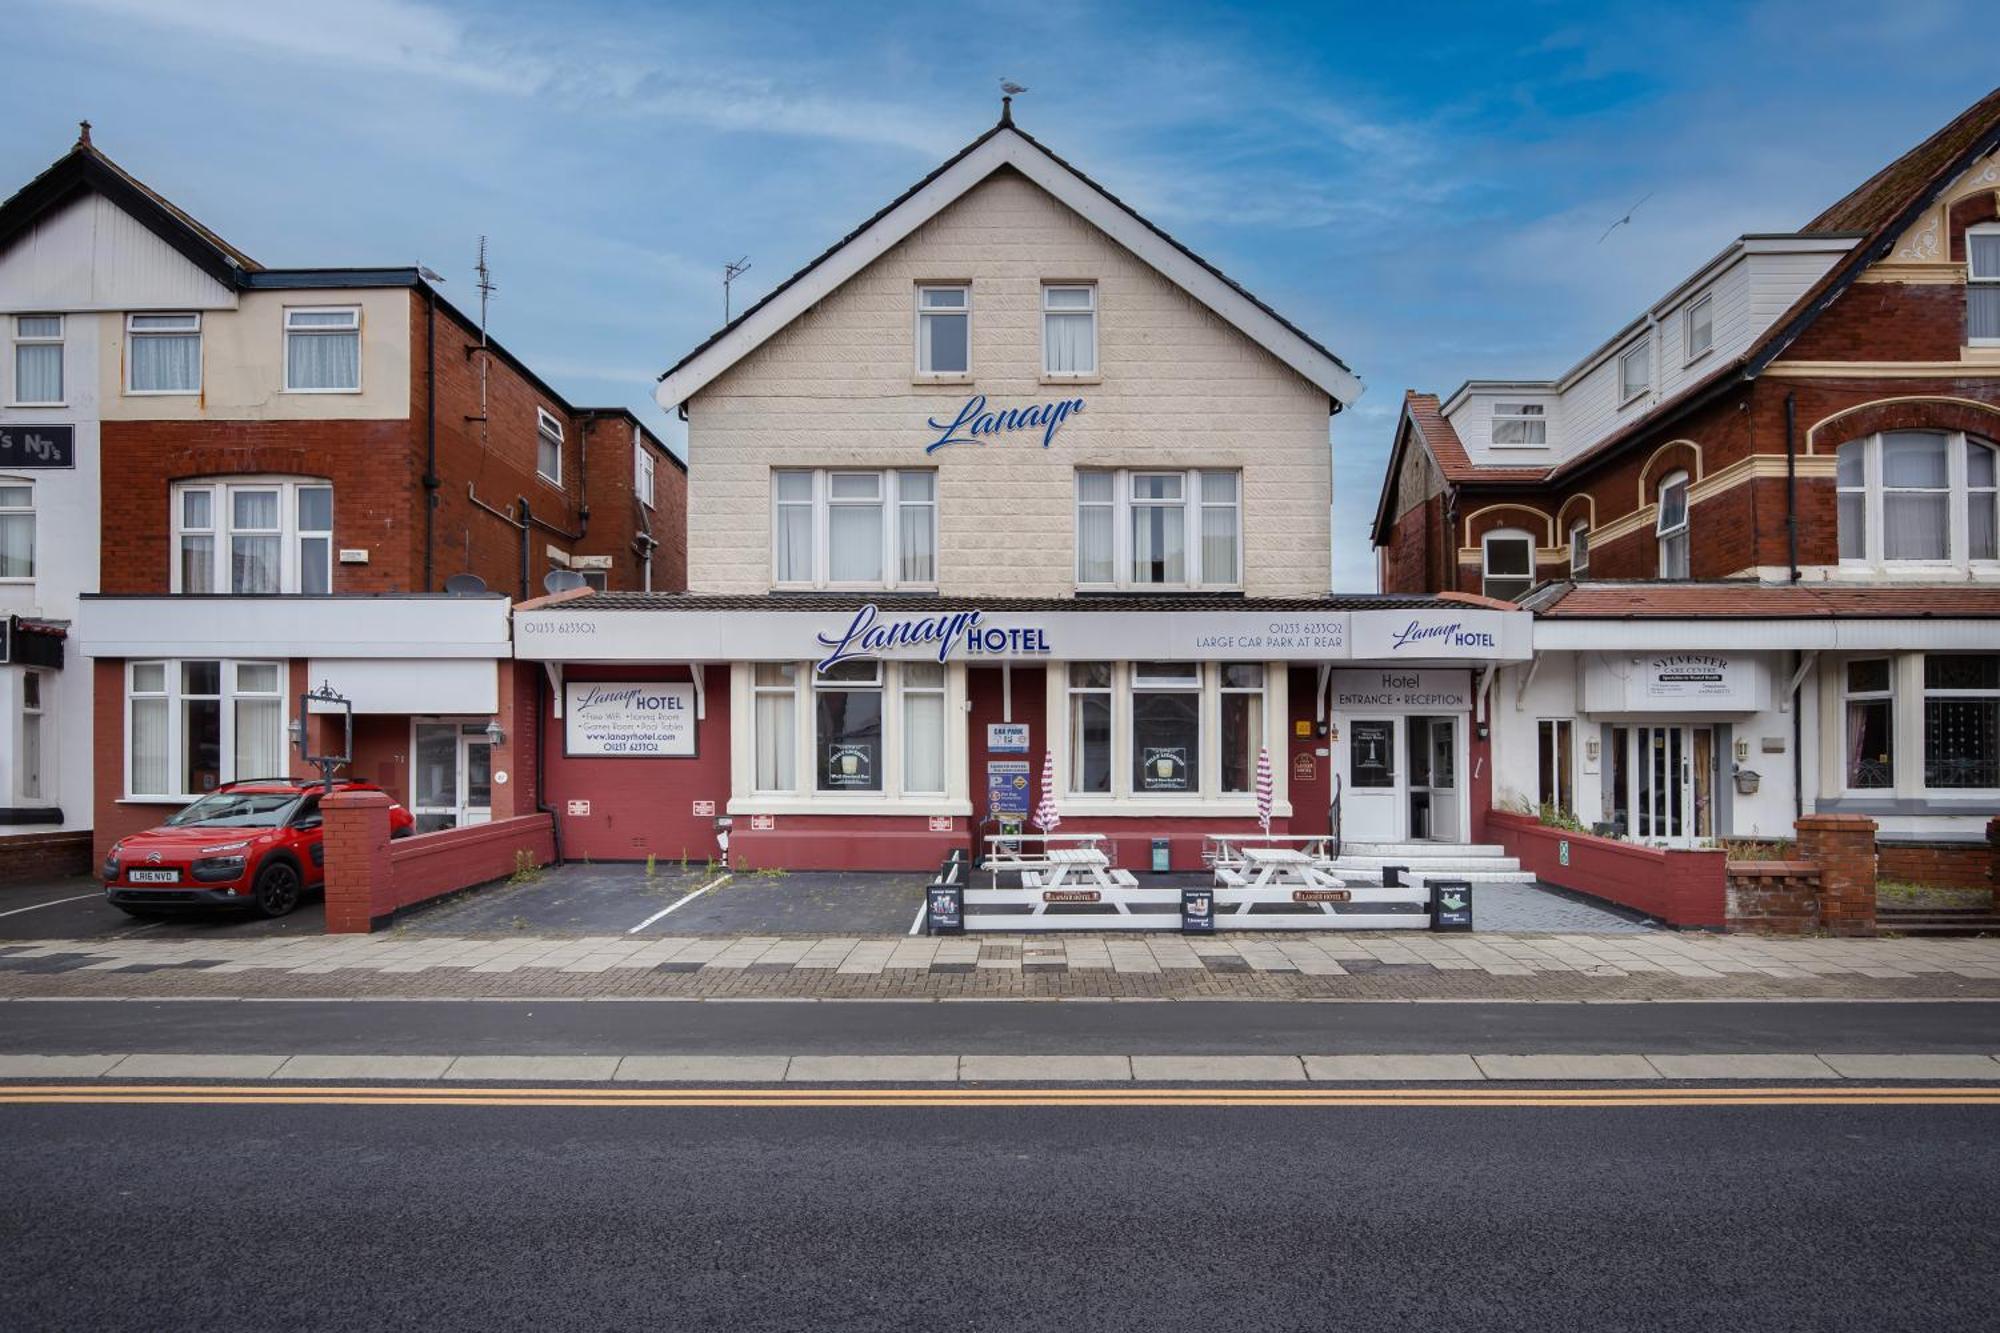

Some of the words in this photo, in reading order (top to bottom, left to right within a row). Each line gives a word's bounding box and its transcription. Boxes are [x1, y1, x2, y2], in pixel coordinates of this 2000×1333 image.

[926, 394, 1085, 455] Lanayr
[1269, 623, 1300, 634] 01253
[1303, 623, 1342, 634] 623302
[1392, 620, 1461, 649] Lanayr
[1455, 633, 1495, 646] HOTEL
[817, 604, 982, 673] Lanayr
[967, 628, 1051, 653] HOTEL
[1196, 636, 1234, 648] LARGE
[1238, 636, 1262, 648] CAR
[1266, 636, 1294, 648] PARK
[1297, 636, 1310, 648] AT
[1314, 636, 1342, 648] REAR
[1652, 655, 1728, 669] SYLVESTER
[1382, 673, 1420, 688] Hotel
[577, 686, 642, 711] Lanayr
[637, 697, 684, 709] HOTEL
[1339, 694, 1393, 705] ENTRANCE
[1404, 694, 1463, 705] RECEPTION
[586, 733, 676, 742] www.lanayrhotel.com
